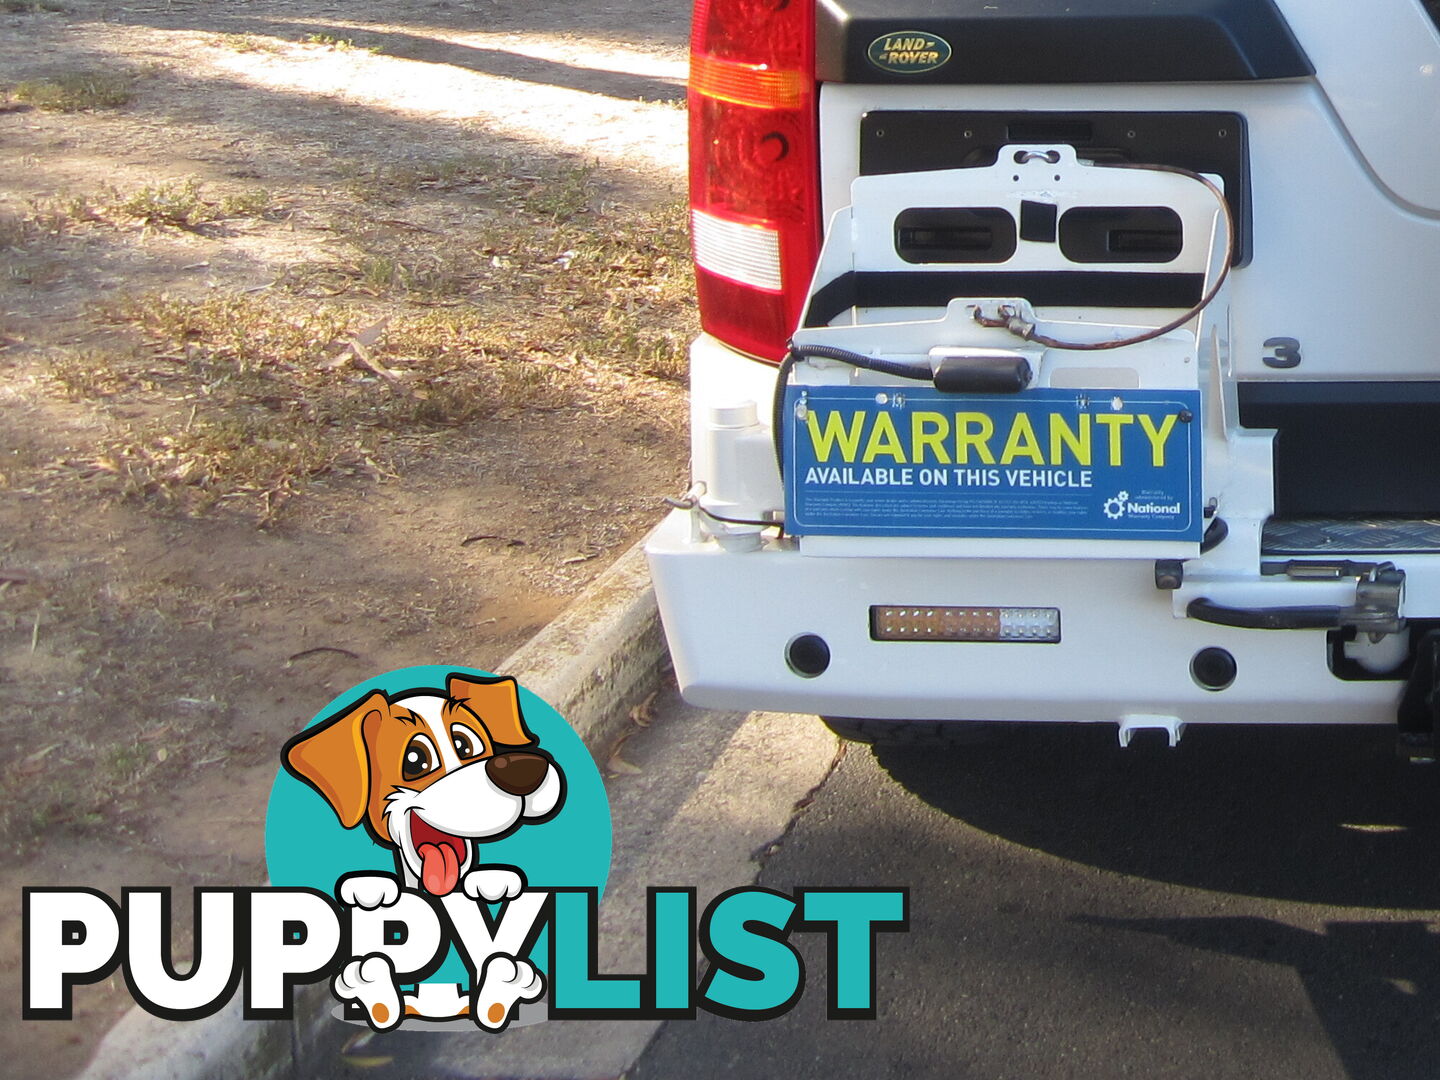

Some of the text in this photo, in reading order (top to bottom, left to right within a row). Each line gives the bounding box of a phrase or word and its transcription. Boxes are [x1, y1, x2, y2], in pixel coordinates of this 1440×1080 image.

[883, 38, 926, 51] LAND
[887, 51, 939, 64] ROVER
[1262, 337, 1301, 369] 3
[805, 410, 1180, 468] WARRANTY
[804, 467, 1093, 488] AVAILABLE ON THIS VEHICLE
[1127, 502, 1181, 514] National
